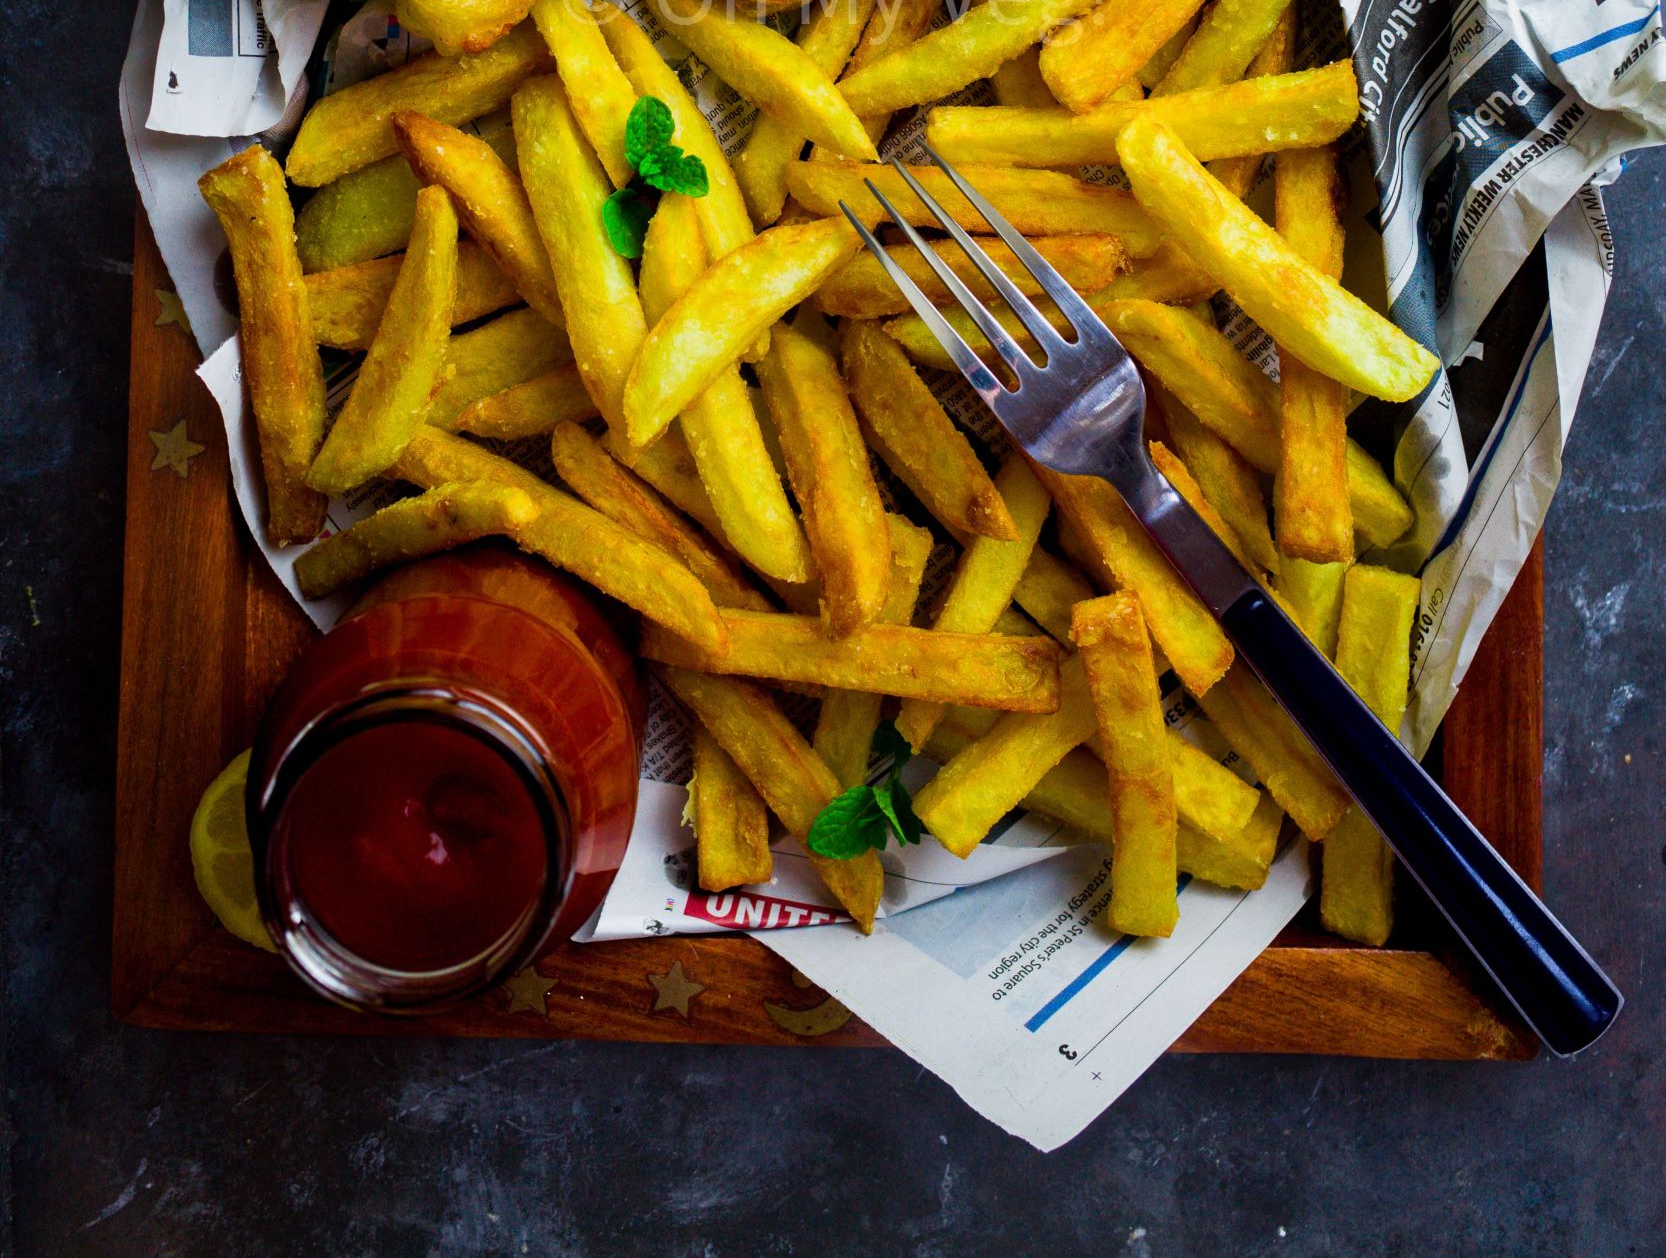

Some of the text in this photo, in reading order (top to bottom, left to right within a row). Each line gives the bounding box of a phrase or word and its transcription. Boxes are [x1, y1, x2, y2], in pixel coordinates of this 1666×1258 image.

[1451, 19, 1483, 56] Public
[1613, 38, 1648, 81] NEWS
[717, 103, 747, 130] should
[1359, 80, 1383, 126] Cit
[1452, 72, 1537, 153] Public
[718, 125, 737, 145] may
[1496, 100, 1586, 183] MANCHESTER
[1462, 179, 1502, 230] WEEKLY
[1426, 586, 1446, 616] Call
[705, 894, 860, 929] UNITE
[987, 868, 1110, 979] strategy for the city region
[1078, 915, 1094, 926] in
[1066, 924, 1083, 936] St
[1036, 933, 1072, 961] Peter's
[1002, 958, 1041, 990] Square
[991, 988, 1007, 1000] to
[1058, 1044, 1078, 1061] 3
